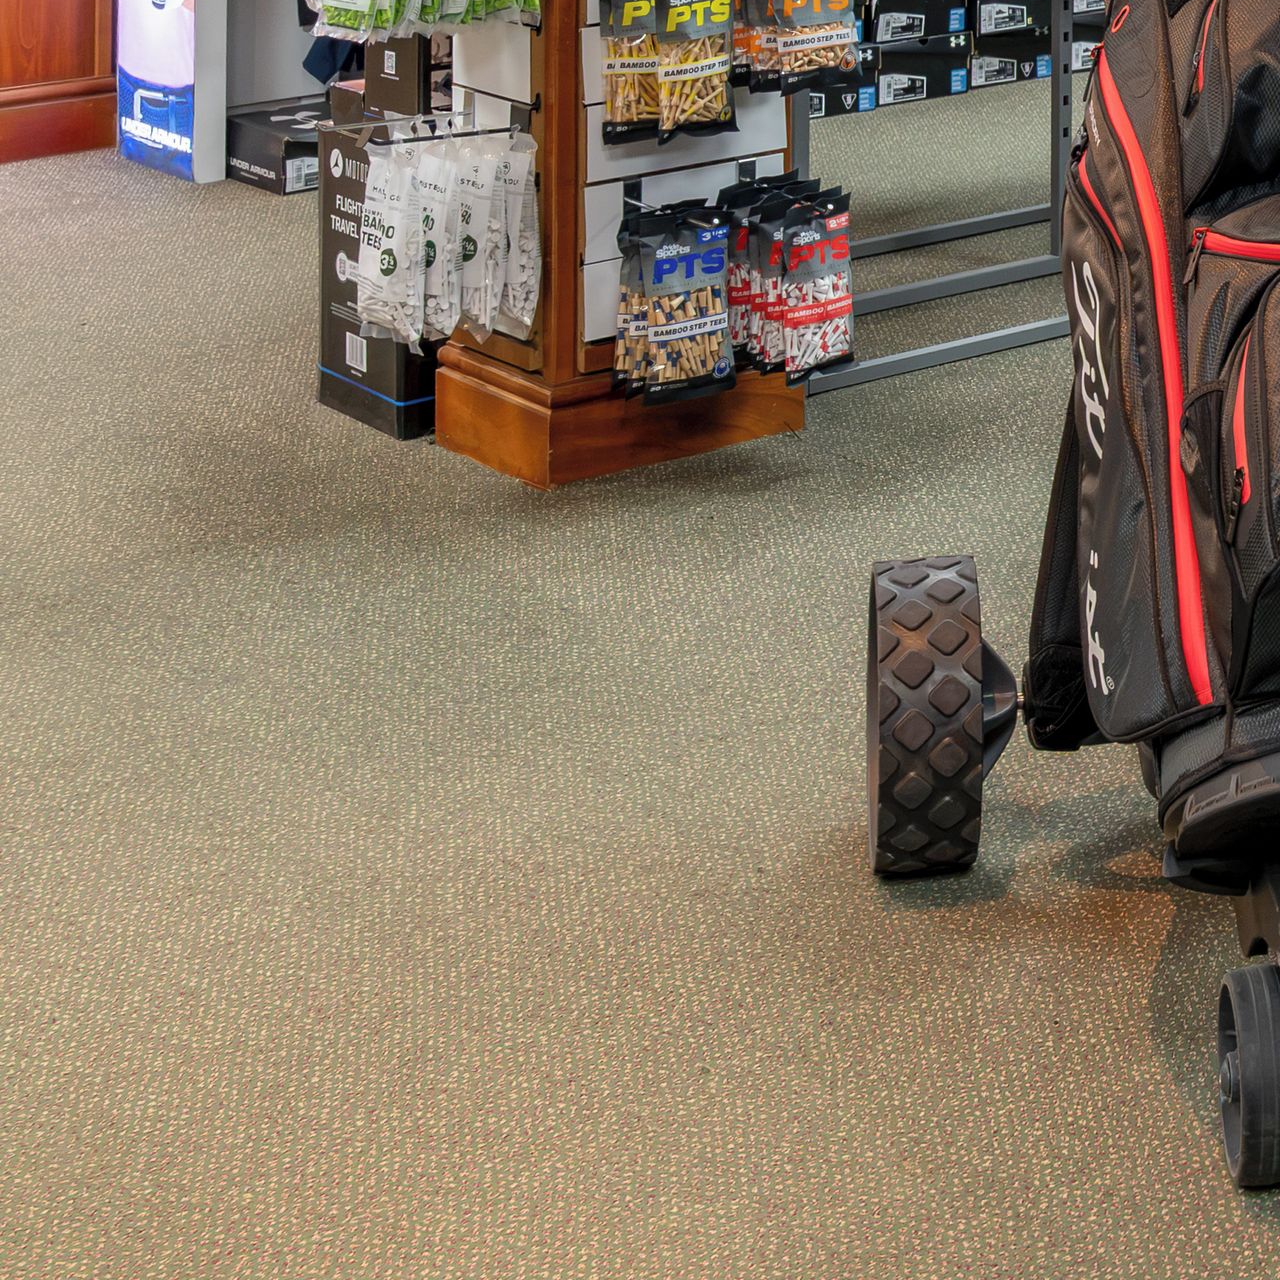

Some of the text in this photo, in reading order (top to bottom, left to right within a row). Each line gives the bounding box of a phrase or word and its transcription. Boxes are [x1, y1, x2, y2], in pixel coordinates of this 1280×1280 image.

[783, 32, 850, 48] BAMBOO STEP TEES
[620, 61, 656, 69] BAMBOO
[664, 66, 700, 78] BAMBOO
[700, 62, 716, 73] STEP
[121, 116, 192, 154] UNDER ARMOUR
[230, 157, 276, 181] UNDER ARMOUR
[330, 214, 359, 239] TRAVEL
[362, 231, 382, 250] TEES
[662, 243, 681, 252] Pride
[793, 233, 821, 247] Sports
[655, 245, 691, 260] Sports
[788, 234, 850, 271] PTS
[652, 247, 726, 285] PTS
[787, 305, 825, 319] BAMBOO
[653, 316, 728, 338] BAMBOO STEP TEES
